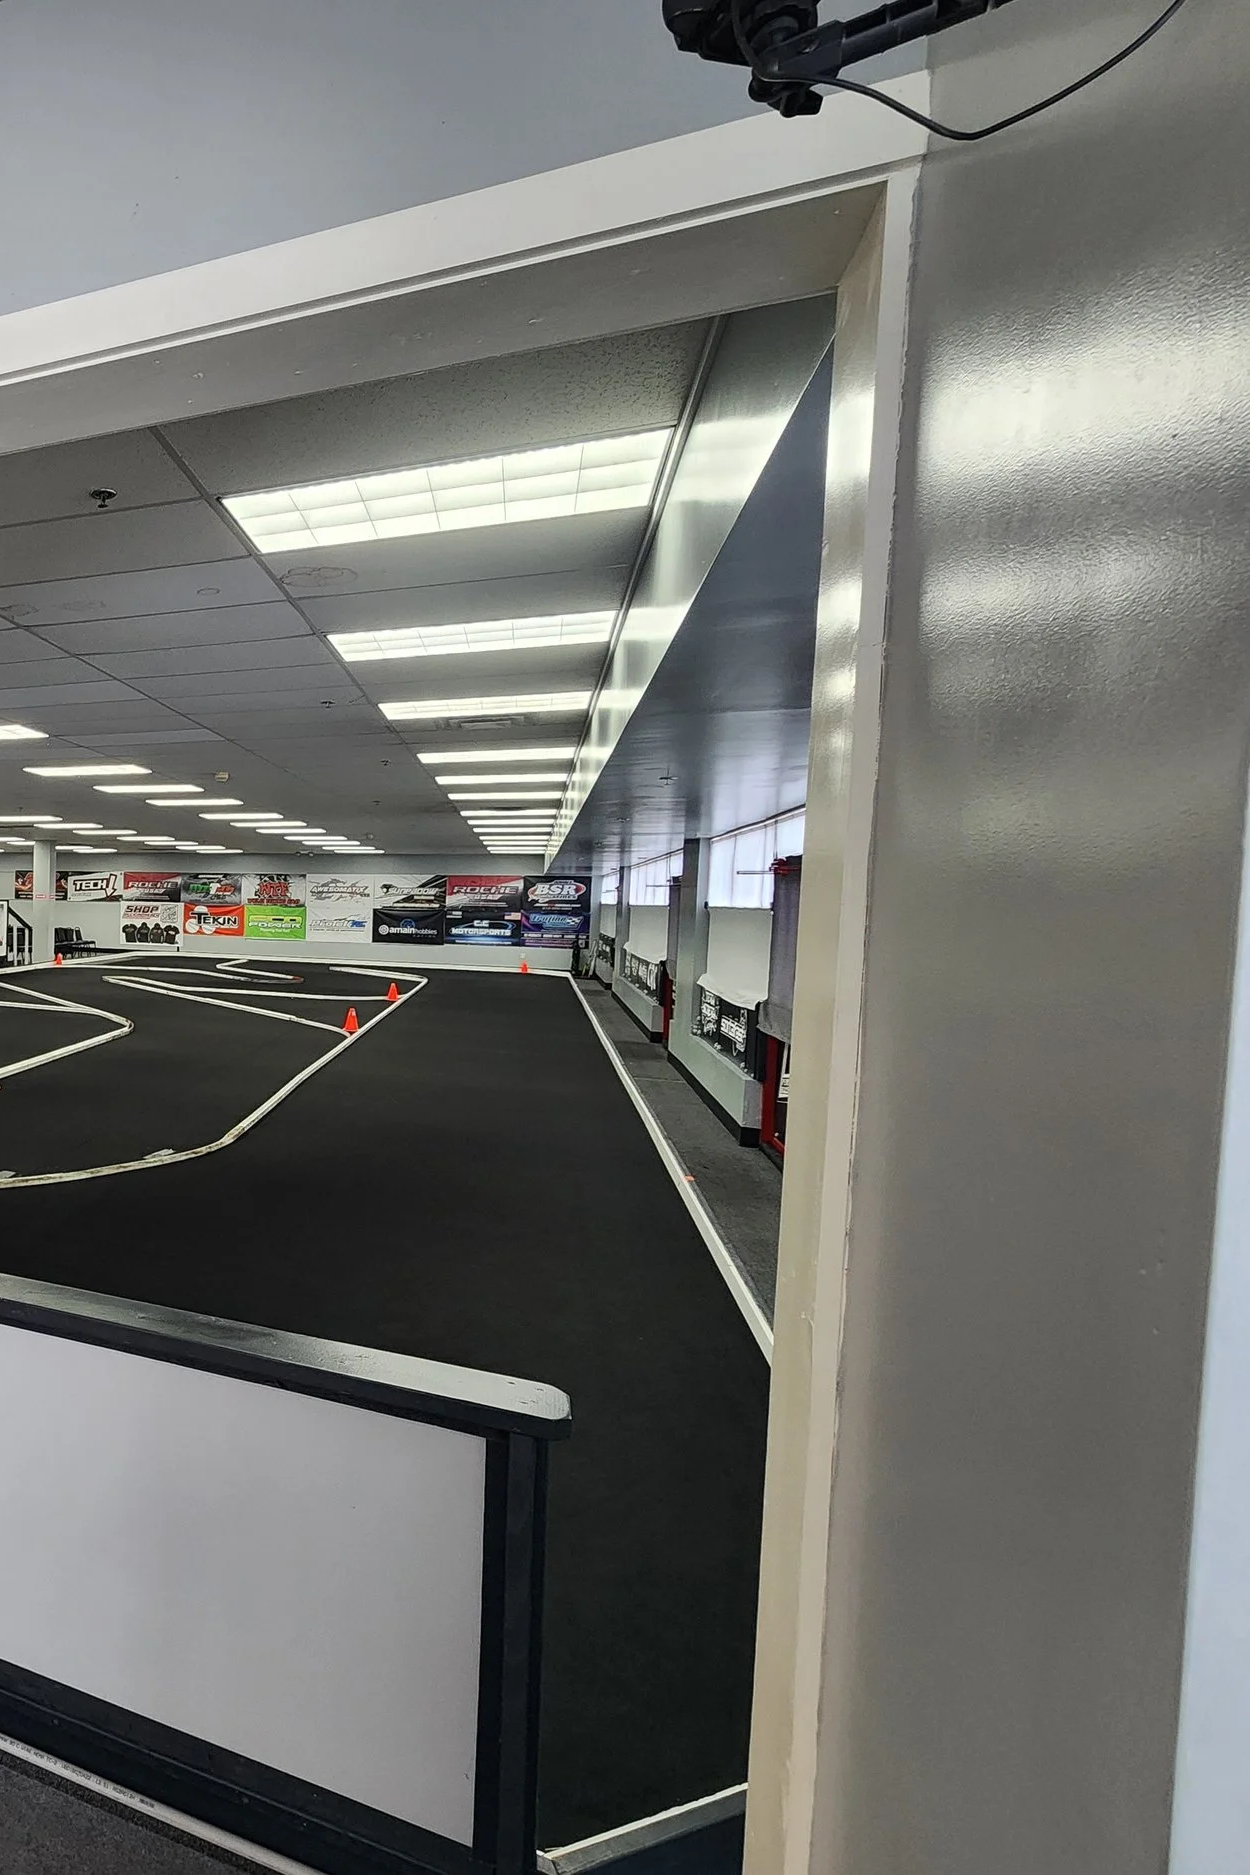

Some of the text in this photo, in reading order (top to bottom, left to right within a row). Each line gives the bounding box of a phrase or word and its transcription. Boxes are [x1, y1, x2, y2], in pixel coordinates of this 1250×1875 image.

[74, 879, 107, 891] TECH
[128, 881, 179, 889] ROCHE
[535, 884, 576, 895] BSR
[453, 886, 518, 894] ROCHE
[125, 905, 159, 914] SHOP
[190, 912, 237, 926] TEKIN
[451, 928, 512, 936] MOTORSPORTS
